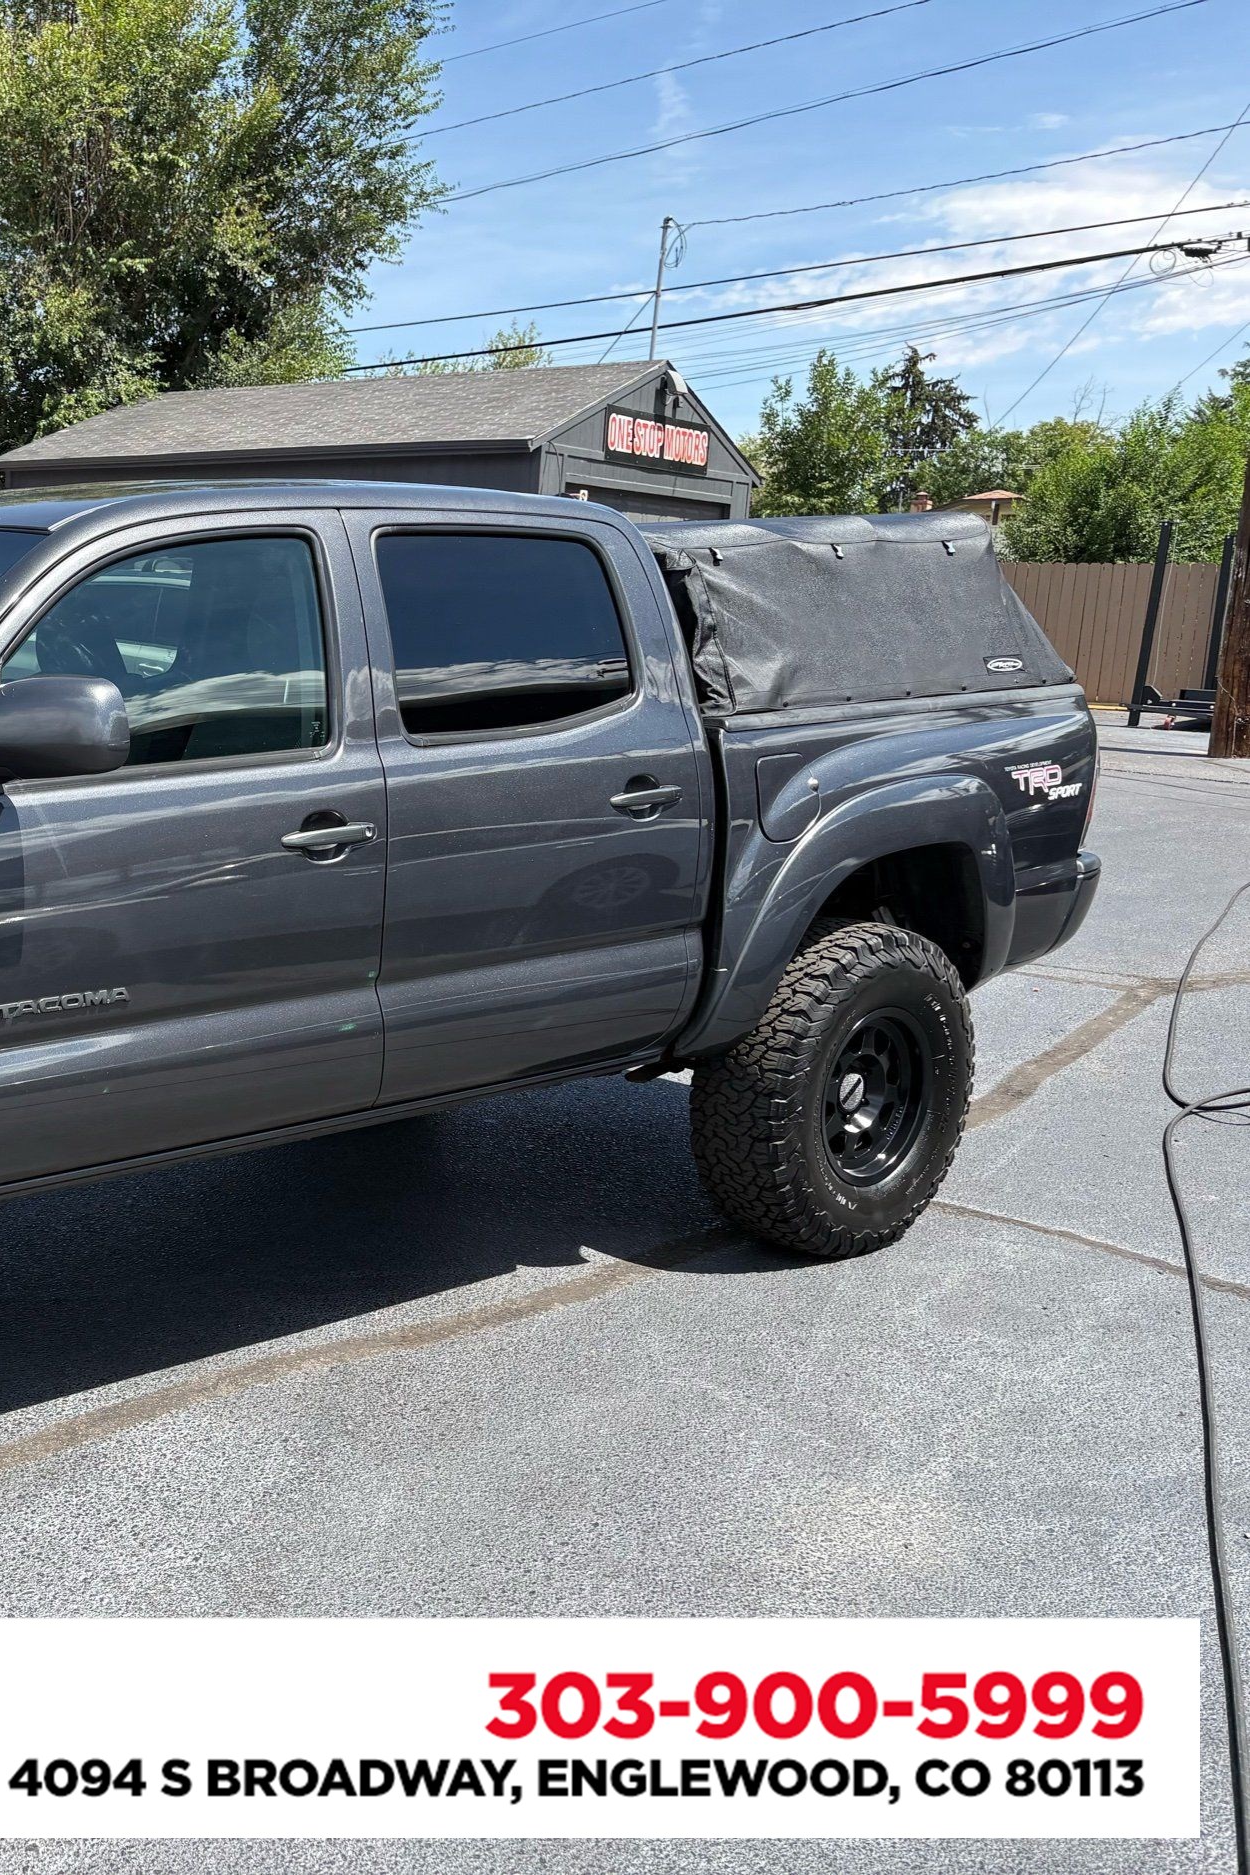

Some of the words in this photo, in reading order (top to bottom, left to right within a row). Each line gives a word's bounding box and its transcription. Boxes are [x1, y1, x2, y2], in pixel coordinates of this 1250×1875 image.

[608, 413, 633, 453] ONE
[633, 419, 664, 458] STOP
[663, 425, 708, 466] MOTORS
[1011, 765, 1062, 795] TRD
[1048, 783, 1082, 800] SPORT
